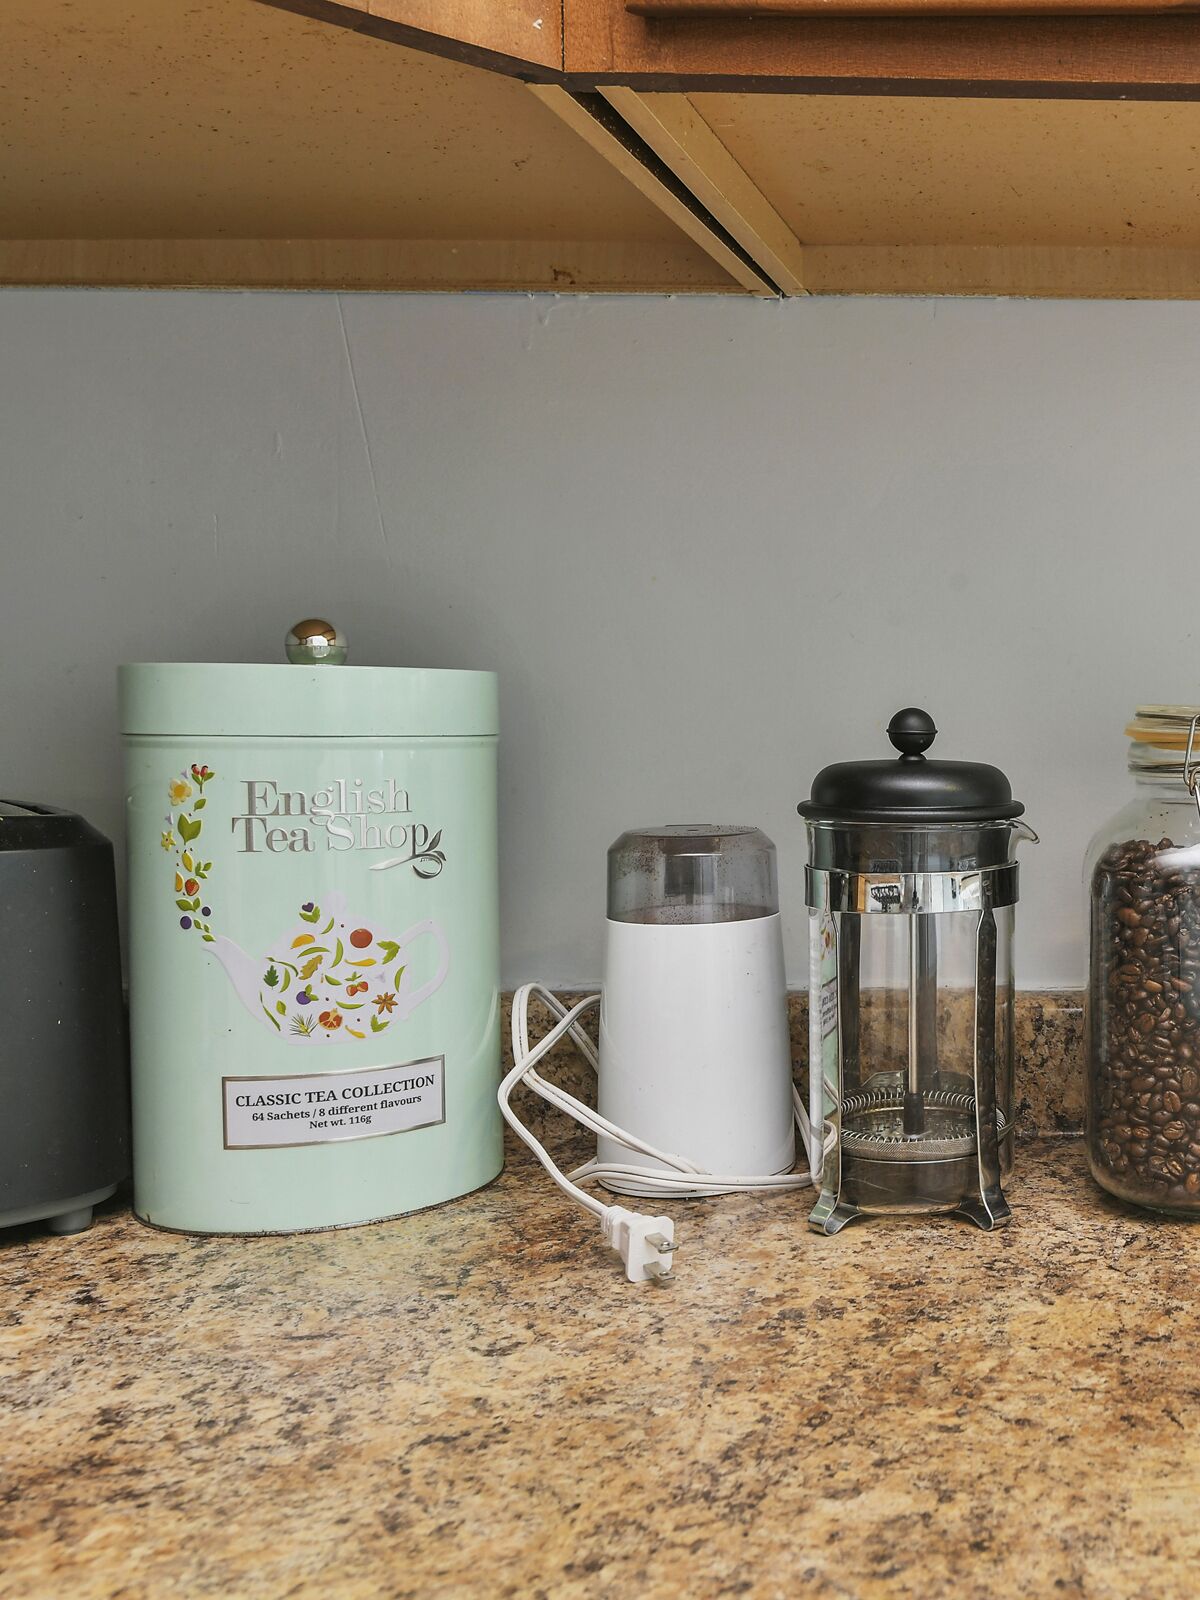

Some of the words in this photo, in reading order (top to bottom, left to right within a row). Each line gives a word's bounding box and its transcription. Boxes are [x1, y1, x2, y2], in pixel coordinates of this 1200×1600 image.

[240, 779, 412, 826] English
[232, 817, 315, 853] Tea
[328, 815, 429, 858] Shop
[236, 1093, 301, 1107] CLASSIC
[305, 1090, 338, 1103] TEA
[342, 1075, 435, 1099] COLLECTION
[252, 1113, 264, 1121] 64
[267, 1109, 310, 1121] Sachets
[313, 1109, 317, 1118] /
[319, 1108, 325, 1117] 8
[328, 1101, 377, 1115] different
[380, 1094, 422, 1110] flavours
[309, 1120, 328, 1128] Net
[330, 1118, 346, 1127] wt.
[349, 1115, 372, 1125] 116g
